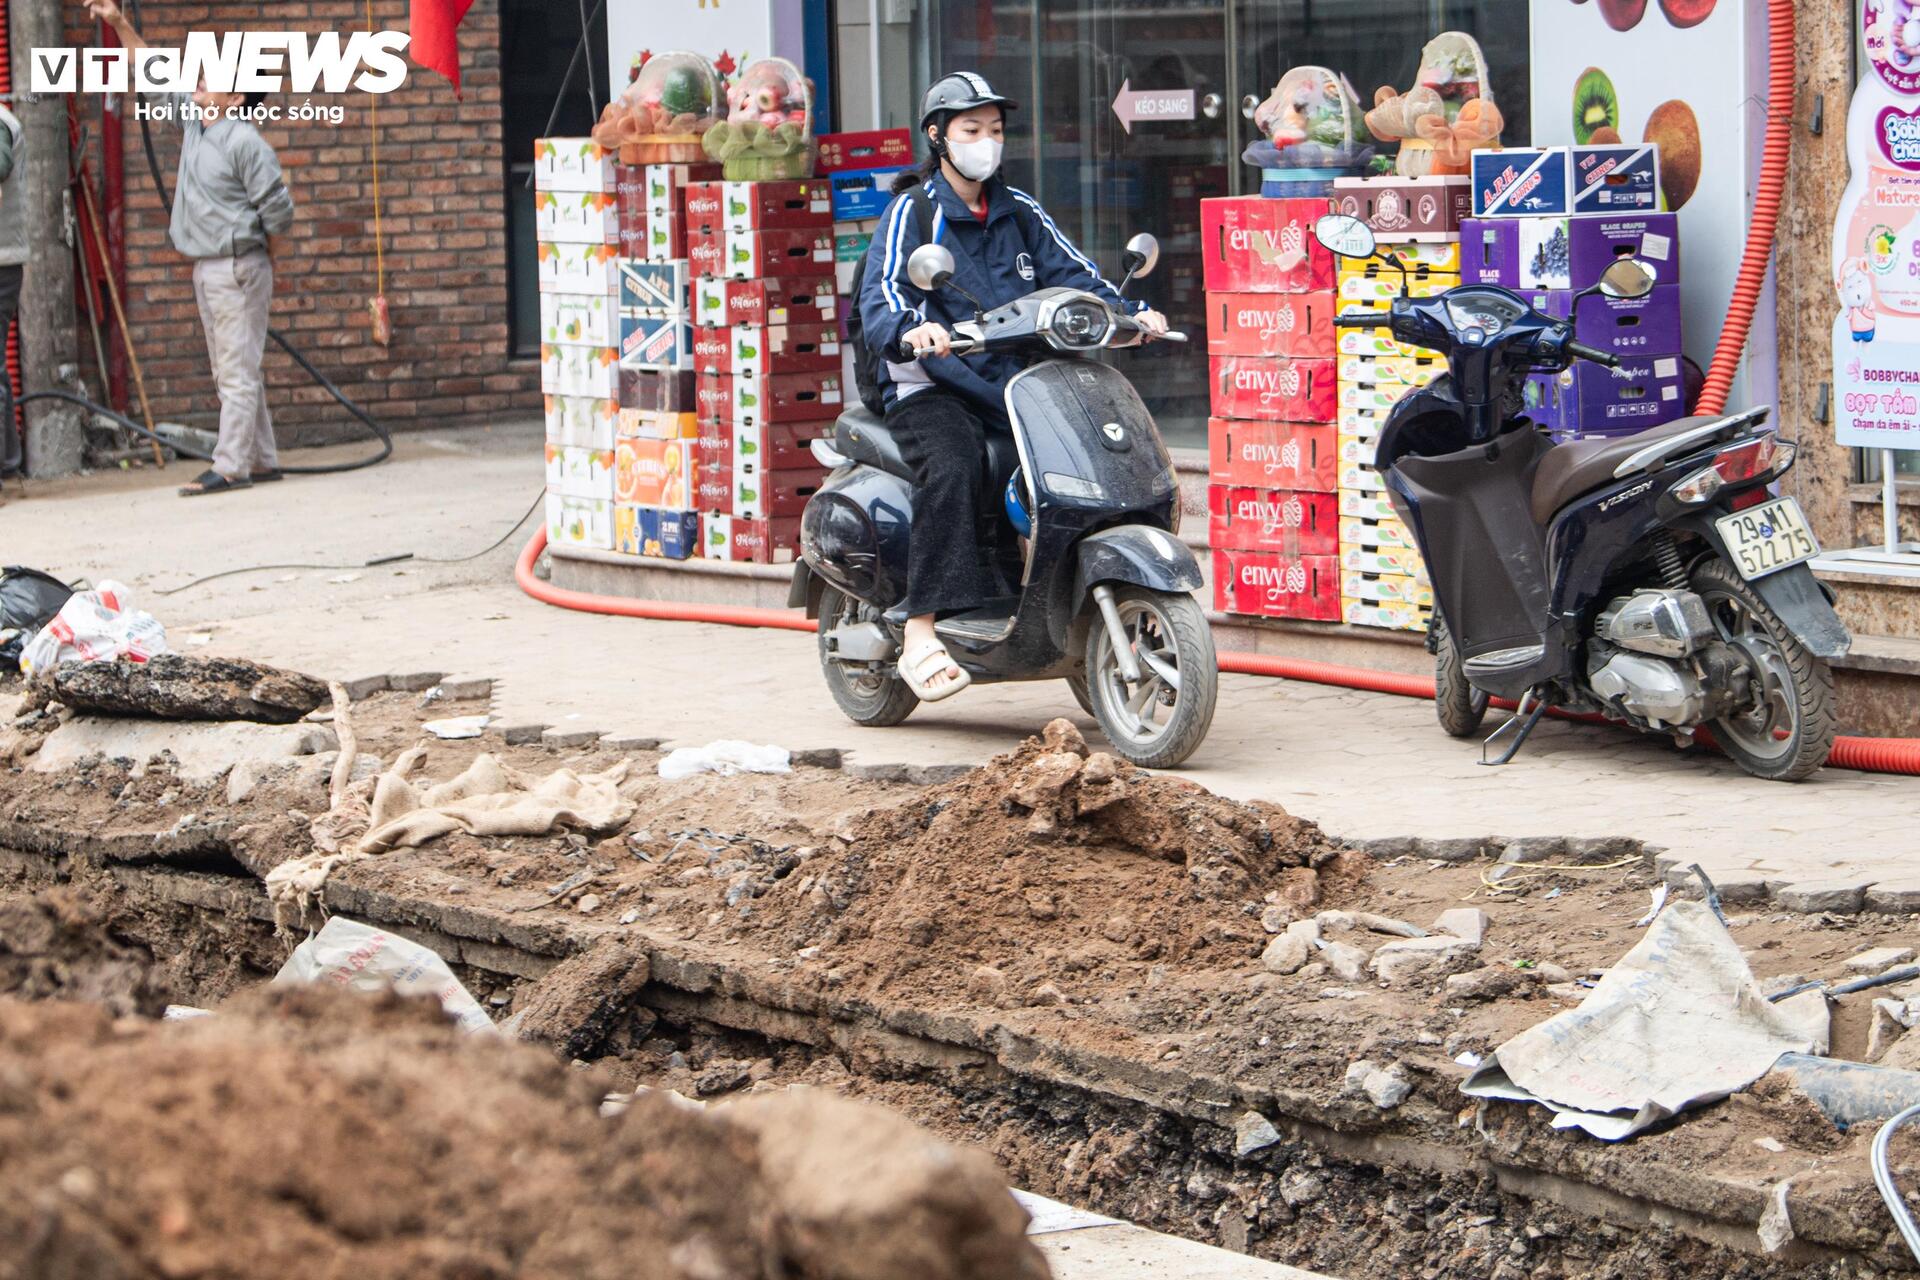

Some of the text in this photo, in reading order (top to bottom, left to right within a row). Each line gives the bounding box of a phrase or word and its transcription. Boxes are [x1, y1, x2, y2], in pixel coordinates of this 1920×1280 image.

[1158, 98, 1188, 114] SANG
[1479, 268, 1500, 278] BLACK
[1237, 309, 1280, 340] envy
[1235, 369, 1280, 404] envy
[1845, 392, 1878, 416] BỌT
[1853, 418, 1874, 431] Chạm
[1877, 419, 1886, 429] da
[1242, 443, 1283, 475] envy
[1597, 479, 1653, 512] VISION
[1238, 500, 1284, 535] envy
[1738, 528, 1812, 574] 522.75
[1241, 565, 1288, 601] envy
